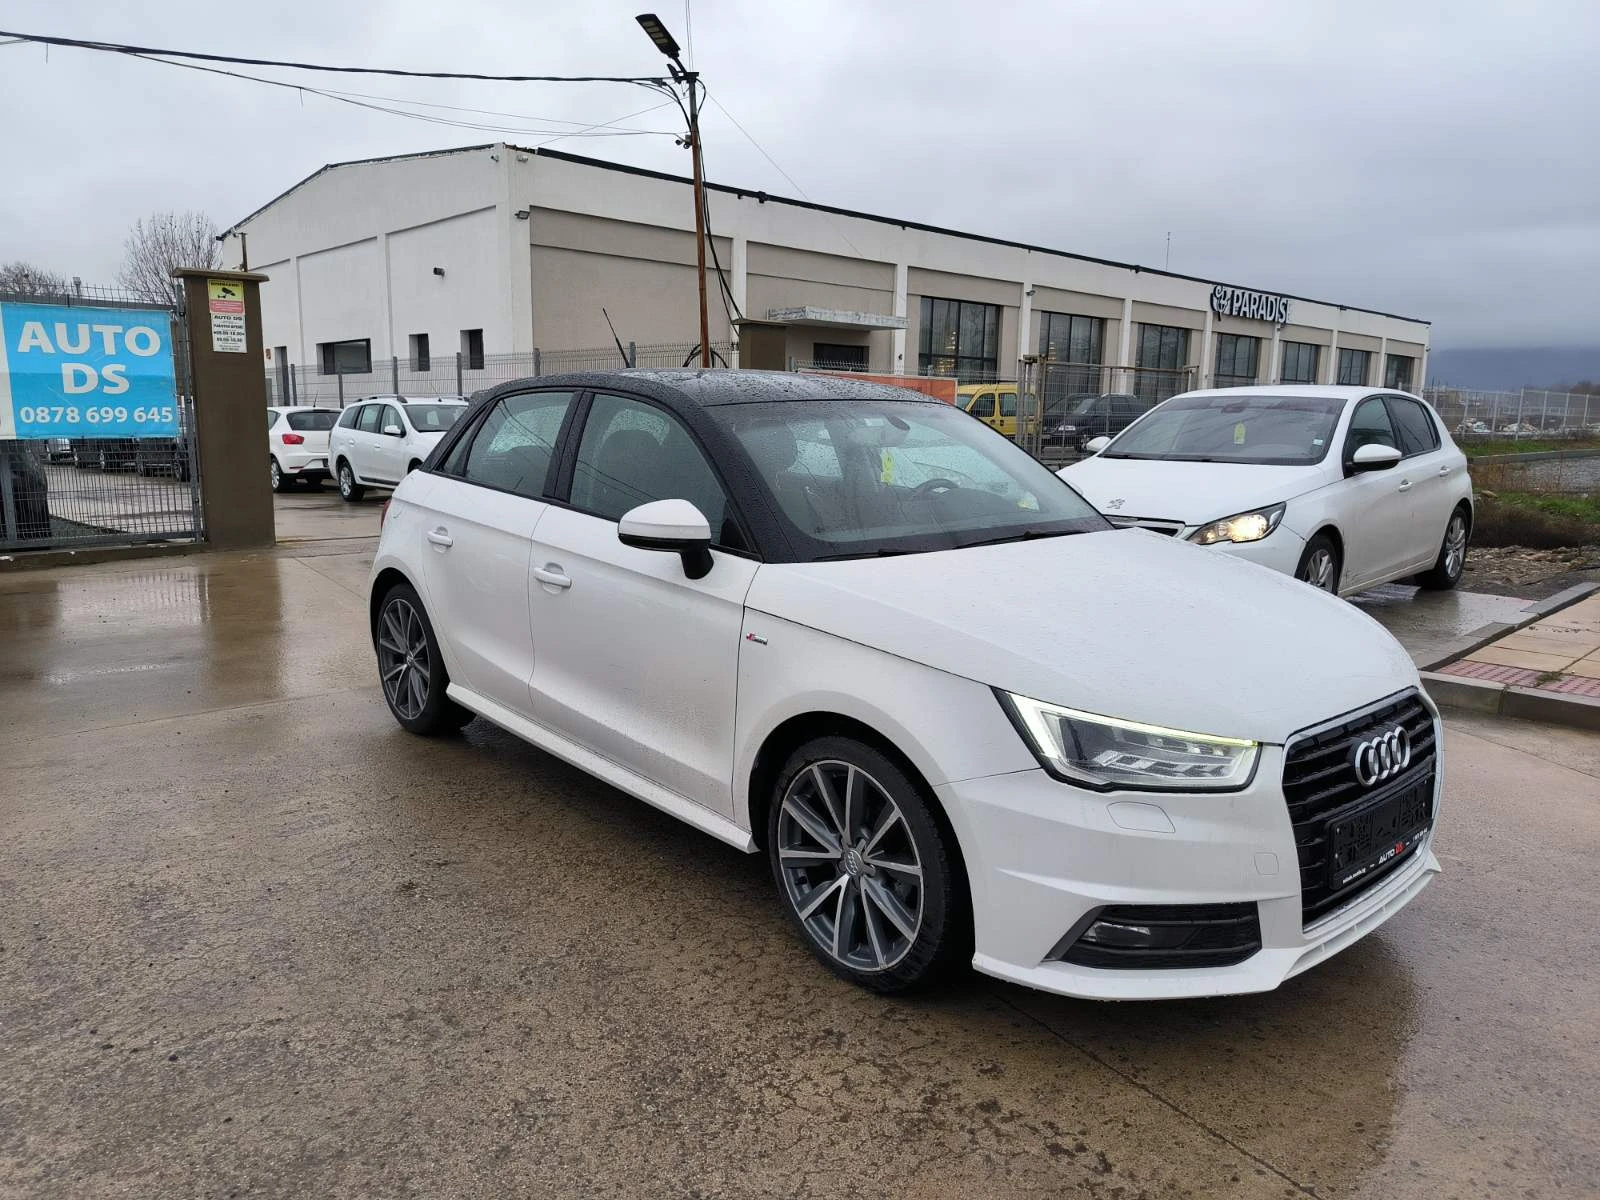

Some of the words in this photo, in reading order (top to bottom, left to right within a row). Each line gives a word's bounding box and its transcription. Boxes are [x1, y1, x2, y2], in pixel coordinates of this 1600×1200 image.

[17, 321, 161, 357] AUTO
[61, 362, 130, 395] DS
[19, 406, 81, 424] 0878
[86, 406, 128, 424] 699
[133, 406, 173, 423] 645
[1378, 848, 1395, 865] AUTO
